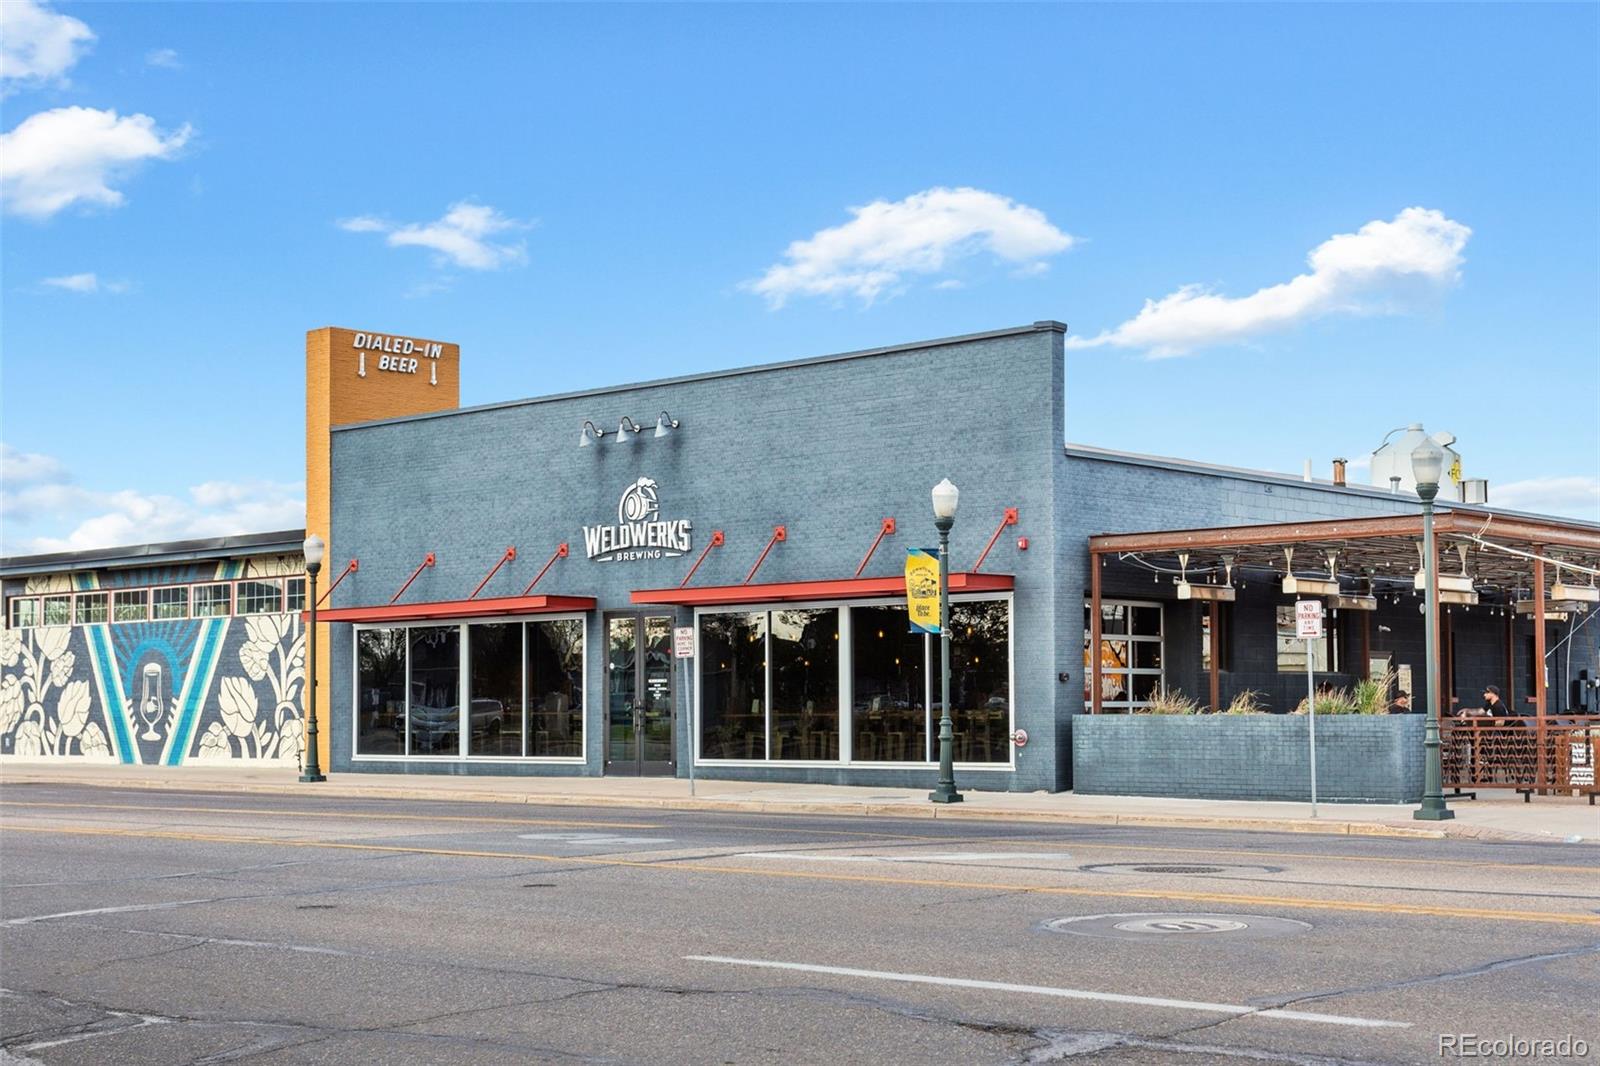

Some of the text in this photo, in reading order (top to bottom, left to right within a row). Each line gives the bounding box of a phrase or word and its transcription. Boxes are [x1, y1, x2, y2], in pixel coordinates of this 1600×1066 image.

[353, 333, 442, 359] DIALED-IN
[378, 355, 418, 374] BEER
[582, 519, 692, 559] WELDWERKS
[616, 550, 661, 561] BREWING
